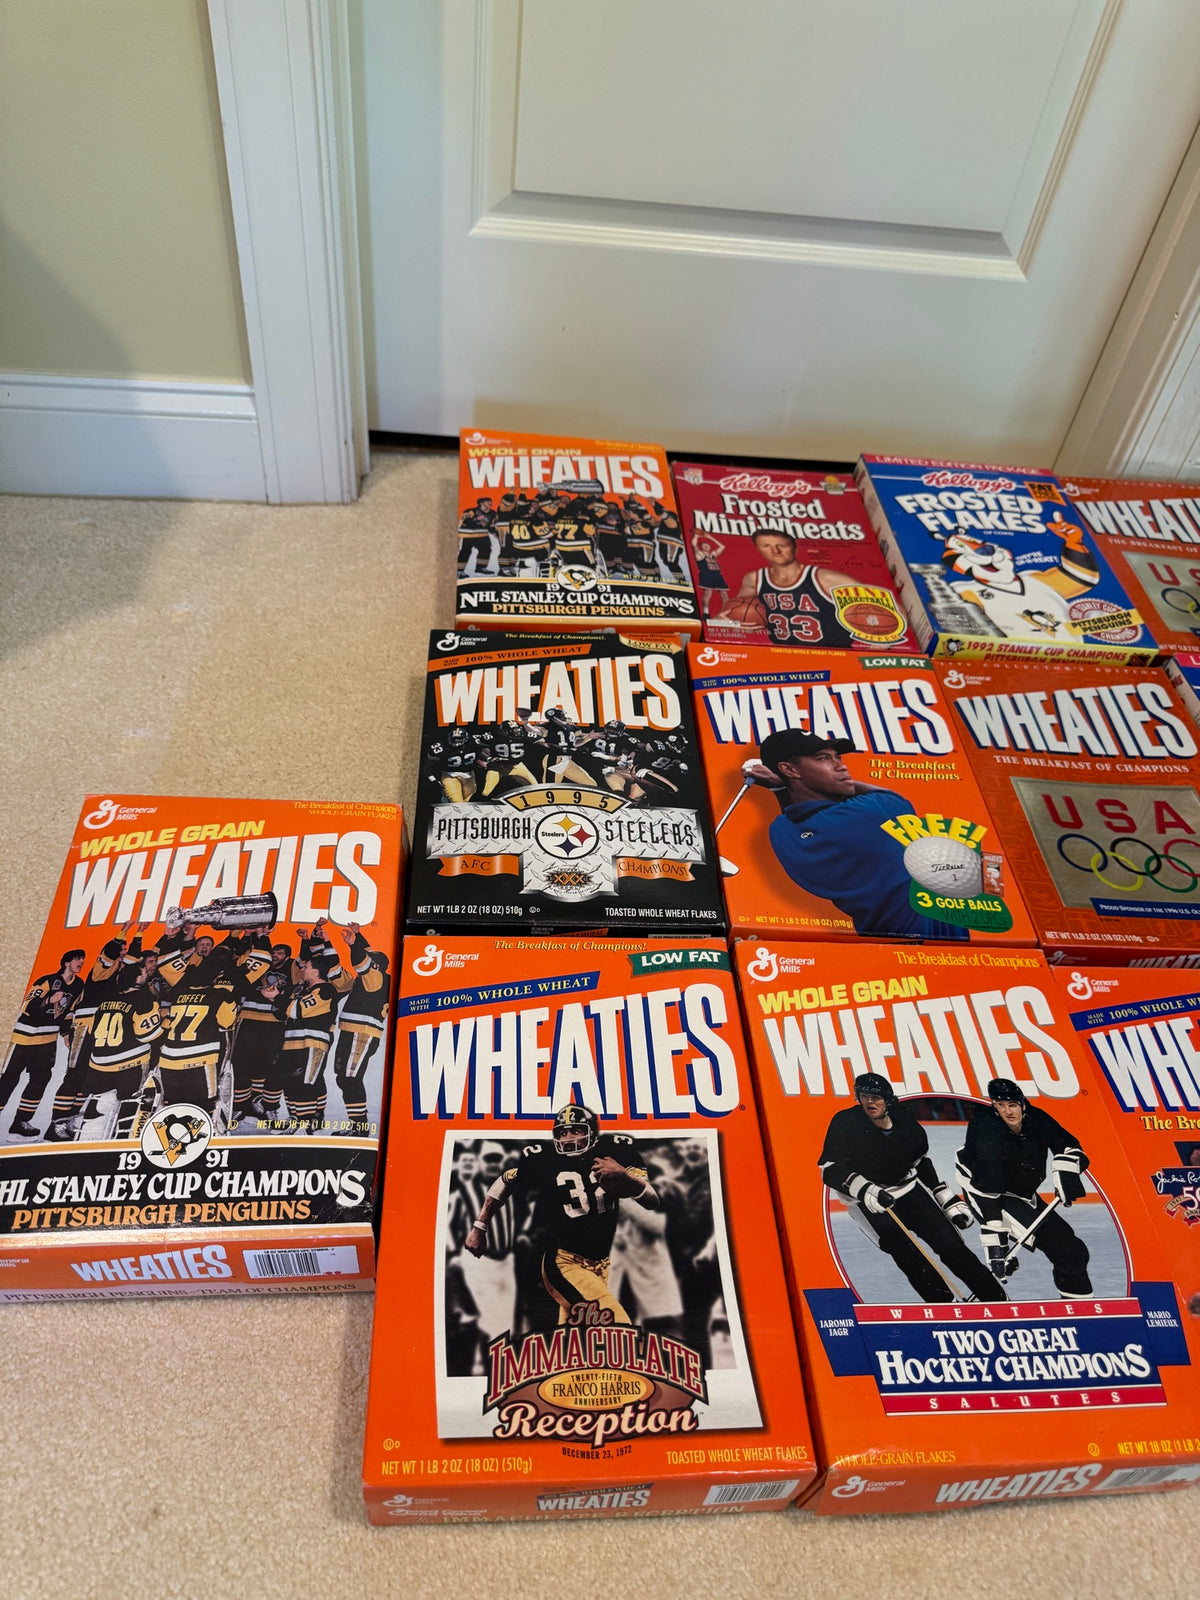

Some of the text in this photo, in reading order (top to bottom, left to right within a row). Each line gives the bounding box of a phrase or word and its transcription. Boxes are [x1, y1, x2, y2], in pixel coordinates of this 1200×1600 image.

[468, 448, 582, 457] WHOLE GRAIN
[468, 455, 664, 500] WHEATIES
[720, 474, 811, 497] Kellogg's
[922, 471, 1016, 493] Kellogg's
[721, 493, 826, 520] Frosted
[895, 492, 1043, 515] FROSTED
[916, 511, 1047, 534] FLAKES
[459, 591, 694, 614] NHL STANLEY CUP CHAMPIONS
[763, 593, 819, 612] USA
[834, 586, 888, 600] MINI
[492, 603, 665, 617] PITTSBURGH PENGUINS
[838, 596, 895, 611] BASKETBALL
[768, 614, 823, 642] 33
[1071, 611, 1132, 629] PITTSBURGH
[1082, 619, 1133, 633] PENGUINS
[465, 646, 583, 663] 100% WHOLE WHEAT
[966, 640, 995, 651] 1992
[998, 643, 1041, 655] STANLEY
[1044, 646, 1064, 656] CUP
[1066, 648, 1127, 662] CHAMPIONS
[864, 657, 926, 668] LOW FAT
[721, 672, 825, 685] 100% WHOLE WHEAT
[436, 654, 682, 730] WHEATIES
[704, 679, 954, 756] WHEATIES
[954, 683, 1198, 760] WHEATIES
[868, 758, 956, 772] The Breakfast
[993, 755, 1190, 774] THE BREAKFAST OF CHAMPIONS
[869, 769, 960, 782] of Champions
[521, 790, 609, 809] 1995
[116, 813, 138, 821] Mills
[119, 806, 158, 814] General
[309, 809, 397, 821] WHOLE-GRAIN FLAKES
[437, 817, 532, 841] PITTSBURGH
[604, 819, 694, 847] STEELERS
[880, 813, 988, 849] FREE!
[80, 820, 265, 859] WHOLE GRAIN
[459, 859, 491, 872] AFC
[617, 860, 690, 877] CHAMPIONS!
[931, 863, 966, 873] Titleist
[65, 831, 382, 929] WHEATIES
[417, 905, 523, 917] NET WT 1LB 2 OZ (18 OZ) 510g
[916, 892, 1002, 912] 3 GOLF BALLS
[605, 908, 717, 919] TOASTED WHOLE WHEAT FLAKES
[494, 940, 647, 952] The Breakfast of Champions!
[444, 960, 465, 968] Mills
[445, 952, 480, 961] General
[641, 952, 685, 967] LOW
[689, 951, 722, 964] FAT
[779, 957, 815, 966] General
[894, 951, 1040, 970] The Breakfast of Champions
[780, 965, 801, 974] Mills
[177, 994, 206, 1003] COFFEY
[436, 976, 591, 1008] 100% WHOLE WHEAT
[757, 975, 928, 1014] WHOLE GRAIN
[1093, 985, 1111, 993] Mills
[1109, 1007, 1139, 1021] 100%
[1140, 999, 1185, 1015] WHOLE
[94, 1012, 123, 1047] 40
[168, 1005, 209, 1041] 77
[411, 983, 740, 1118] WHEATIES
[762, 985, 1081, 1099] WHEATIES
[1140, 1116, 1174, 1131] The
[117, 1152, 142, 1171] 19
[205, 1150, 229, 1168] 91
[0, 1169, 367, 1208] HL STANLEY CUP CHAMPIONS
[11, 1200, 312, 1230] PITTSBURGH PENGUINS
[71, 1244, 233, 1282] WHEATIES
[568, 1302, 613, 1325] The
[890, 1303, 1103, 1320] WHEATIES
[1147, 1310, 1172, 1320] MARIO
[819, 1318, 855, 1329] JAROMIR
[829, 1327, 849, 1337] JAGR
[1147, 1318, 1179, 1328] LEMIEUX
[932, 1326, 1080, 1356] TWO GREAT
[486, 1327, 704, 1407] IMMACULATE
[875, 1343, 1151, 1386] HOCKEY CHAMPIONS
[571, 1373, 622, 1383] TWENTY-FIFTH
[552, 1380, 641, 1398] FRANCO HARRIS
[573, 1396, 622, 1407] ANNIVERSARY
[929, 1390, 1121, 1410] SALUTES
[494, 1401, 699, 1449] Reception
[562, 1445, 632, 1459] DECEMBER 23, 1972
[666, 1446, 807, 1465] TOASTED WHOLE WHEAT FLAKES
[835, 1450, 957, 1467] WHOLE-GRAIN FLAKES
[382, 1461, 399, 1475] NET
[402, 1460, 417, 1474] WT
[428, 1460, 438, 1473] LB
[442, 1460, 448, 1473] 2
[450, 1459, 462, 1473] OZ
[465, 1459, 480, 1474] (18
[482, 1458, 499, 1473] OZ)
[502, 1457, 533, 1474] (510g)
[935, 1464, 1102, 1503] WHEATIES
[538, 1489, 651, 1511] WHEATIES
